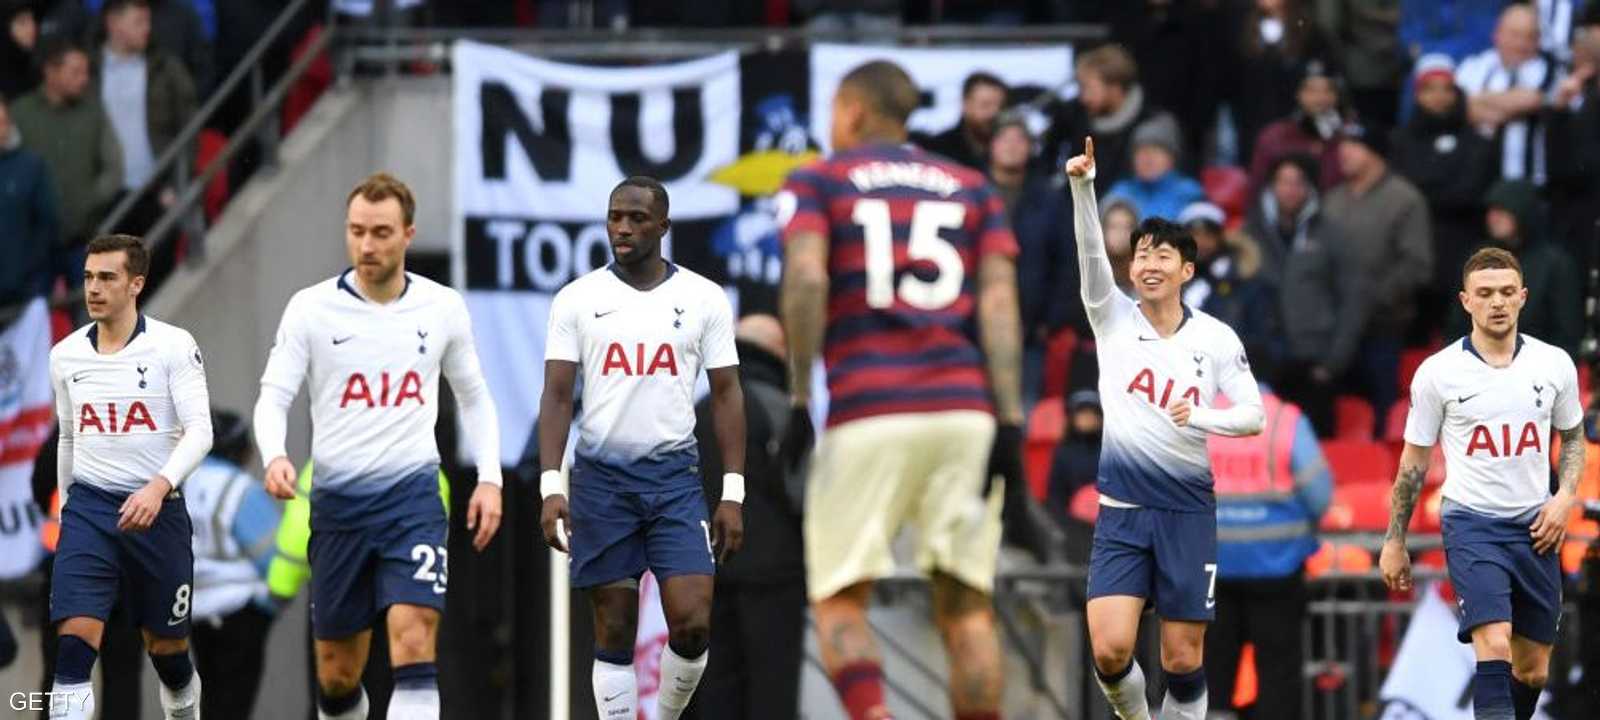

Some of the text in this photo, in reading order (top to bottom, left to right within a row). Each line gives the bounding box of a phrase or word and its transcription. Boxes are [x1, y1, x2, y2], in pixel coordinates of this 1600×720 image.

[852, 199, 966, 311] 15
[602, 341, 678, 376] AIA
[340, 370, 424, 408] AIA
[1127, 368, 1200, 409] AIA
[79, 401, 158, 433] AIA
[1465, 421, 1542, 457] AIA
[1204, 563, 1217, 598] 7
[172, 584, 190, 618] 8
